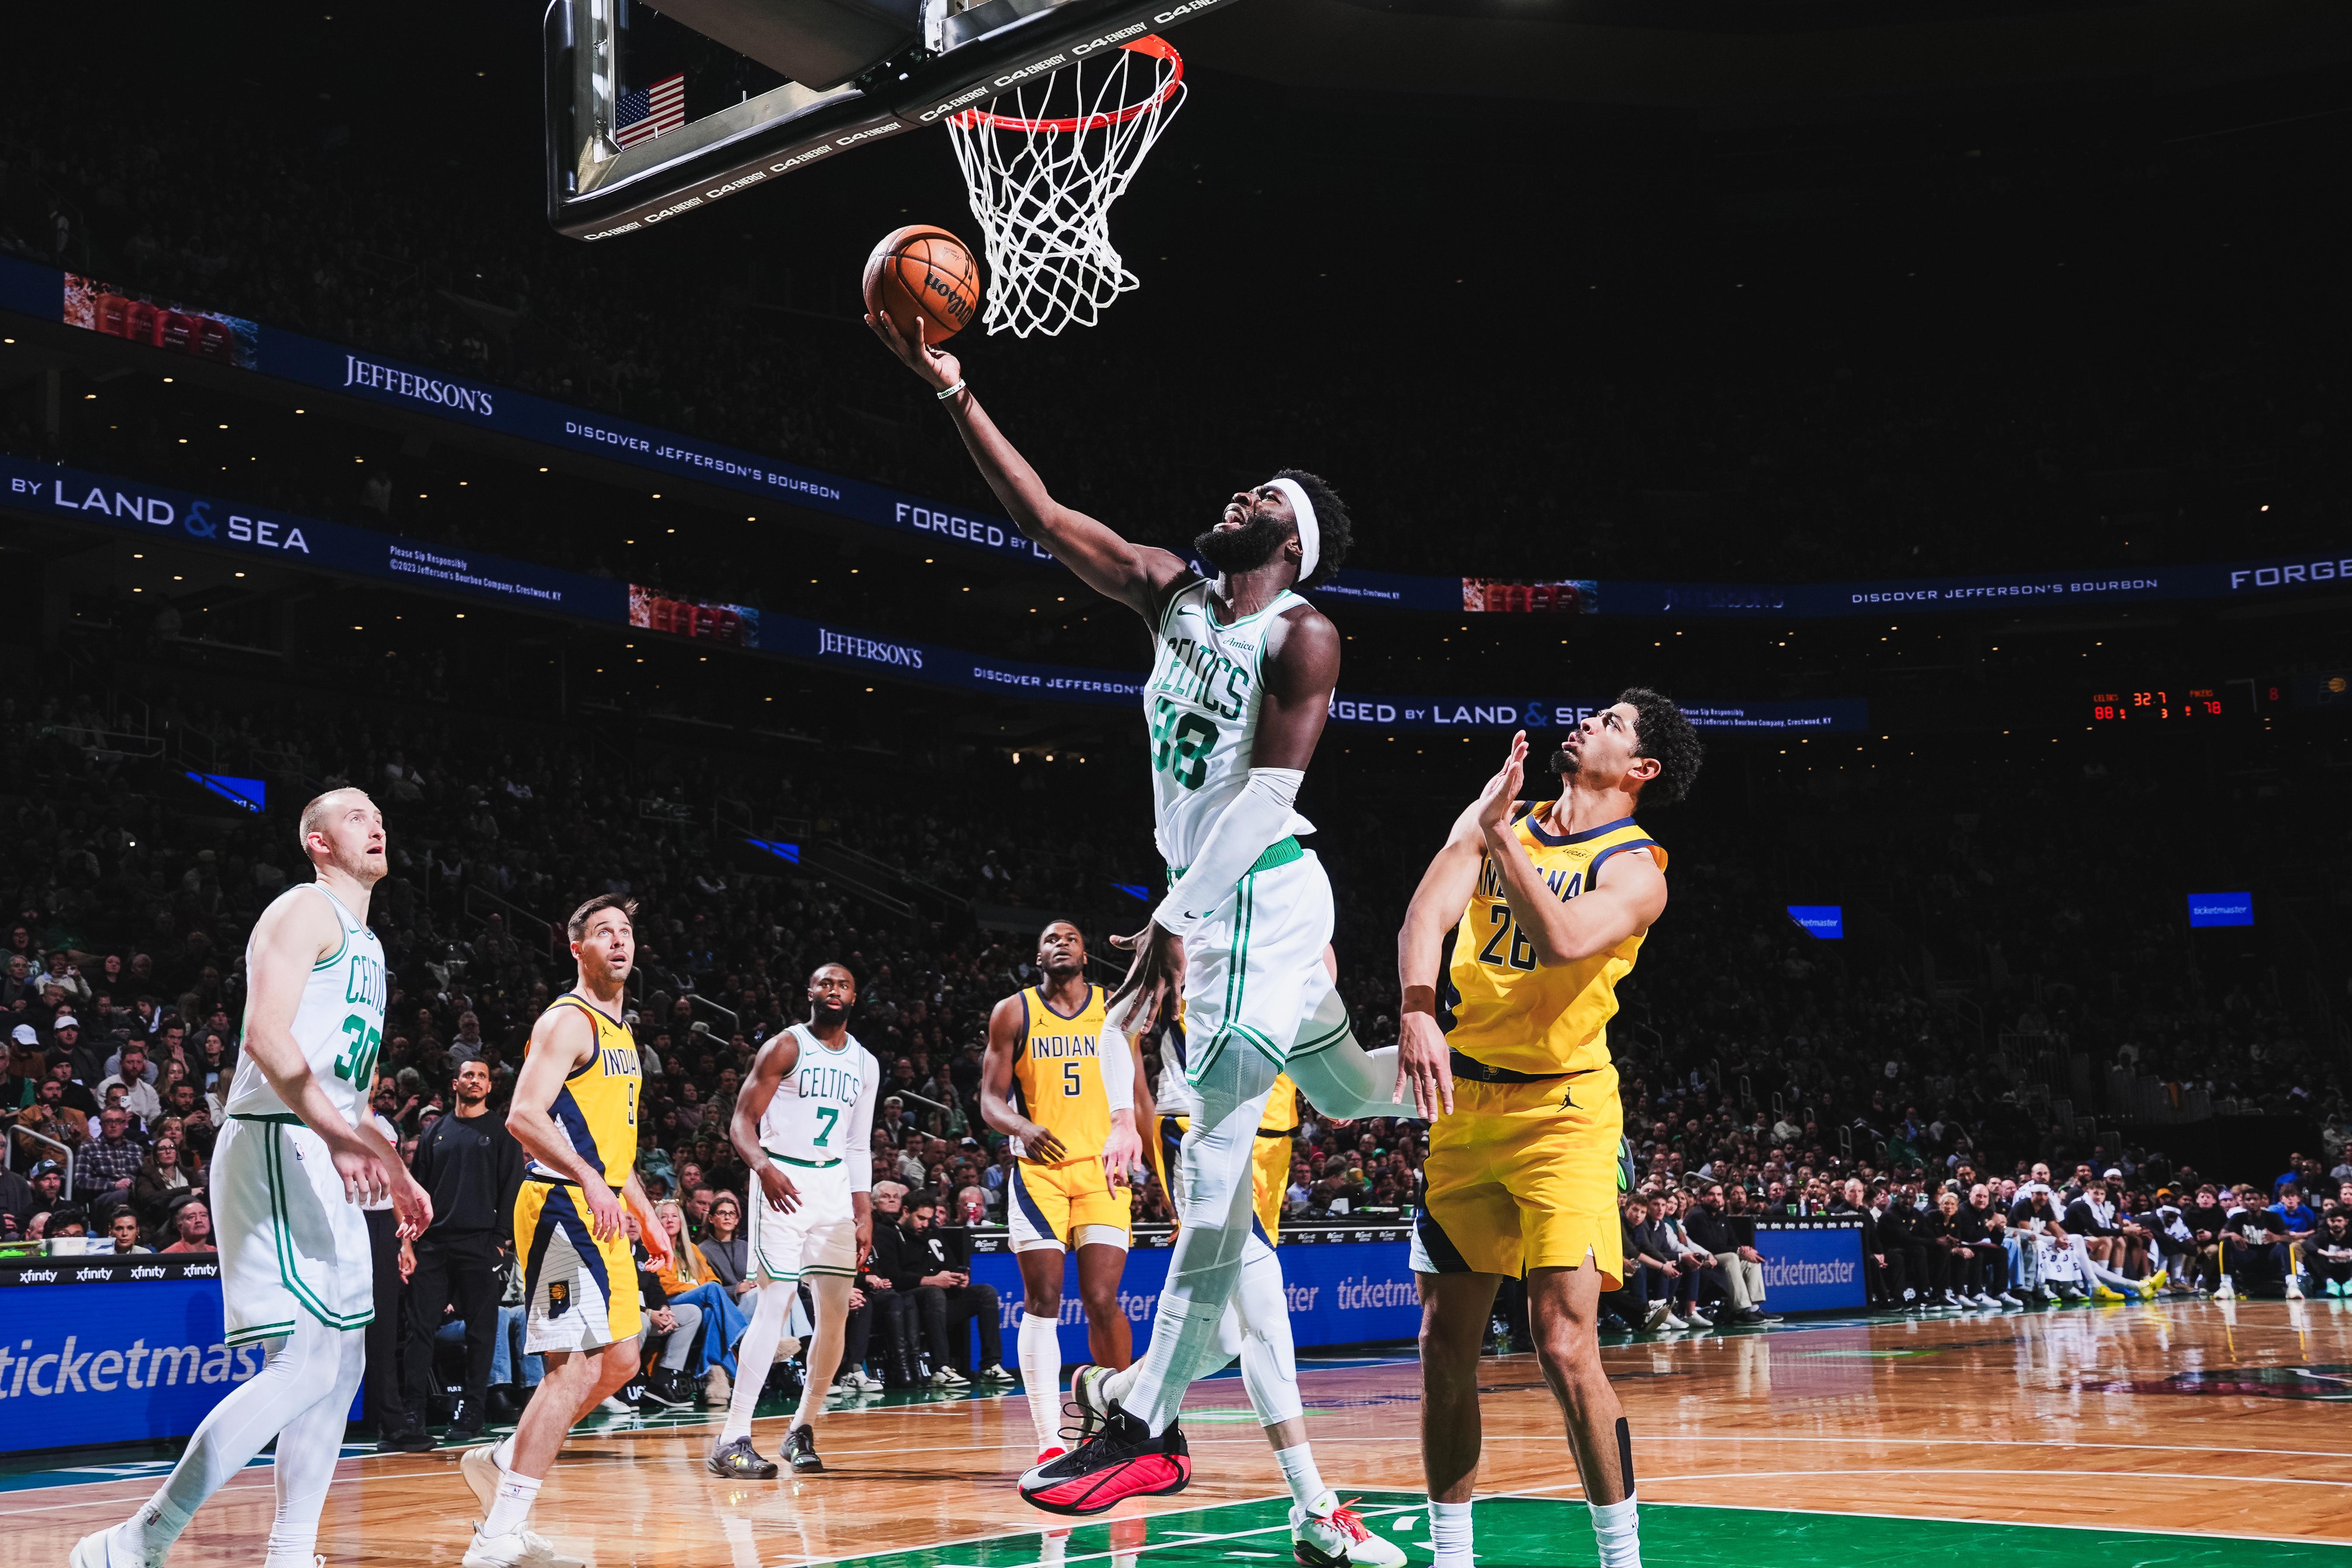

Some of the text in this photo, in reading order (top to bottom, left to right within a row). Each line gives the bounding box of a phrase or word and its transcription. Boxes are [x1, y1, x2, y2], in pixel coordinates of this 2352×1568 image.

[1154, 5, 1192, 24] C4
[1072, 22, 1148, 55] C4 ENERGY
[994, 53, 1066, 87] C4 ENERGY
[919, 86, 989, 122] C4 ENERGY
[836, 122, 902, 146] C4 ENERGY
[770, 145, 832, 172] C4 ENERGY
[706, 171, 767, 199] C4 ENERGY
[645, 197, 703, 223] C4 ENERGY
[583, 221, 641, 241] C4 ENERGY
[343, 355, 492, 416] JEFFERSON'S
[566, 421, 840, 500] DISCOVER JEFFERSON'S BOURBON
[12, 478, 309, 554] BY LAND & SEA
[895, 502, 1028, 550] FORGED BY
[390, 545, 468, 572] Please Sip Responsibly
[417, 565, 454, 581] Jefferson's
[455, 572, 483, 586] Bourbon
[1852, 579, 2158, 603] DISCOVER JEFFERSON'S BOURBON
[818, 627, 922, 669] JEFFERSON'S
[1223, 637, 1255, 651] Amica
[974, 667, 1041, 687] DISCOVER
[1152, 637, 1250, 721] CELTICS
[1328, 700, 1396, 723] RGED
[1405, 709, 1426, 719] BY
[1433, 705, 1518, 725] LAND
[1524, 702, 1548, 727] &
[2095, 706, 2114, 719] 88
[2204, 701, 2222, 714] 78
[1152, 696, 1220, 791] 88
[1563, 849, 1586, 857] LUCAS
[334, 1014, 383, 1092] 30
[1031, 1035, 1100, 1059] INDIAN
[799, 1067, 860, 1108] CELTICS
[1063, 1061, 1081, 1097] 5
[813, 1106, 840, 1147] 7
[19, 1269, 58, 1284] xfinity
[76, 1267, 113, 1282] xfinity
[130, 1265, 166, 1280] xfinity
[183, 1263, 218, 1278] xfinity
[1763, 1256, 1855, 1287] ticketmaster
[1337, 1275, 1422, 1310] ticketma
[0, 1336, 262, 1397] ticketmas
